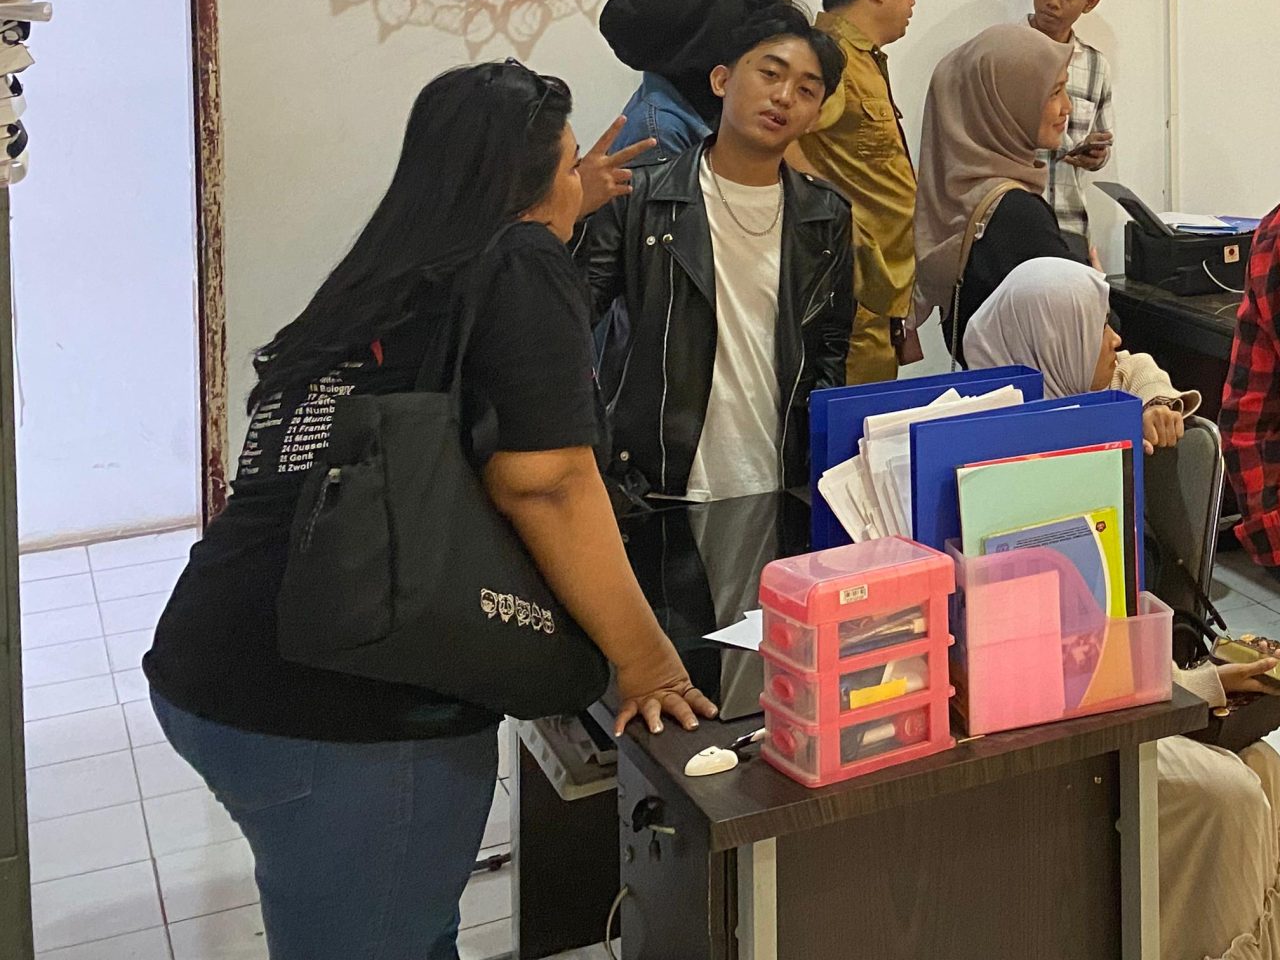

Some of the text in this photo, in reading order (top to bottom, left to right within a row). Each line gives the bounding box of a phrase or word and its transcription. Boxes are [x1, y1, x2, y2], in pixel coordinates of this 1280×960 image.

[303, 415, 332, 424] Munic
[294, 432, 330, 442] Mannh
[289, 451, 314, 462] Genk
[287, 461, 315, 472] Zwoll
